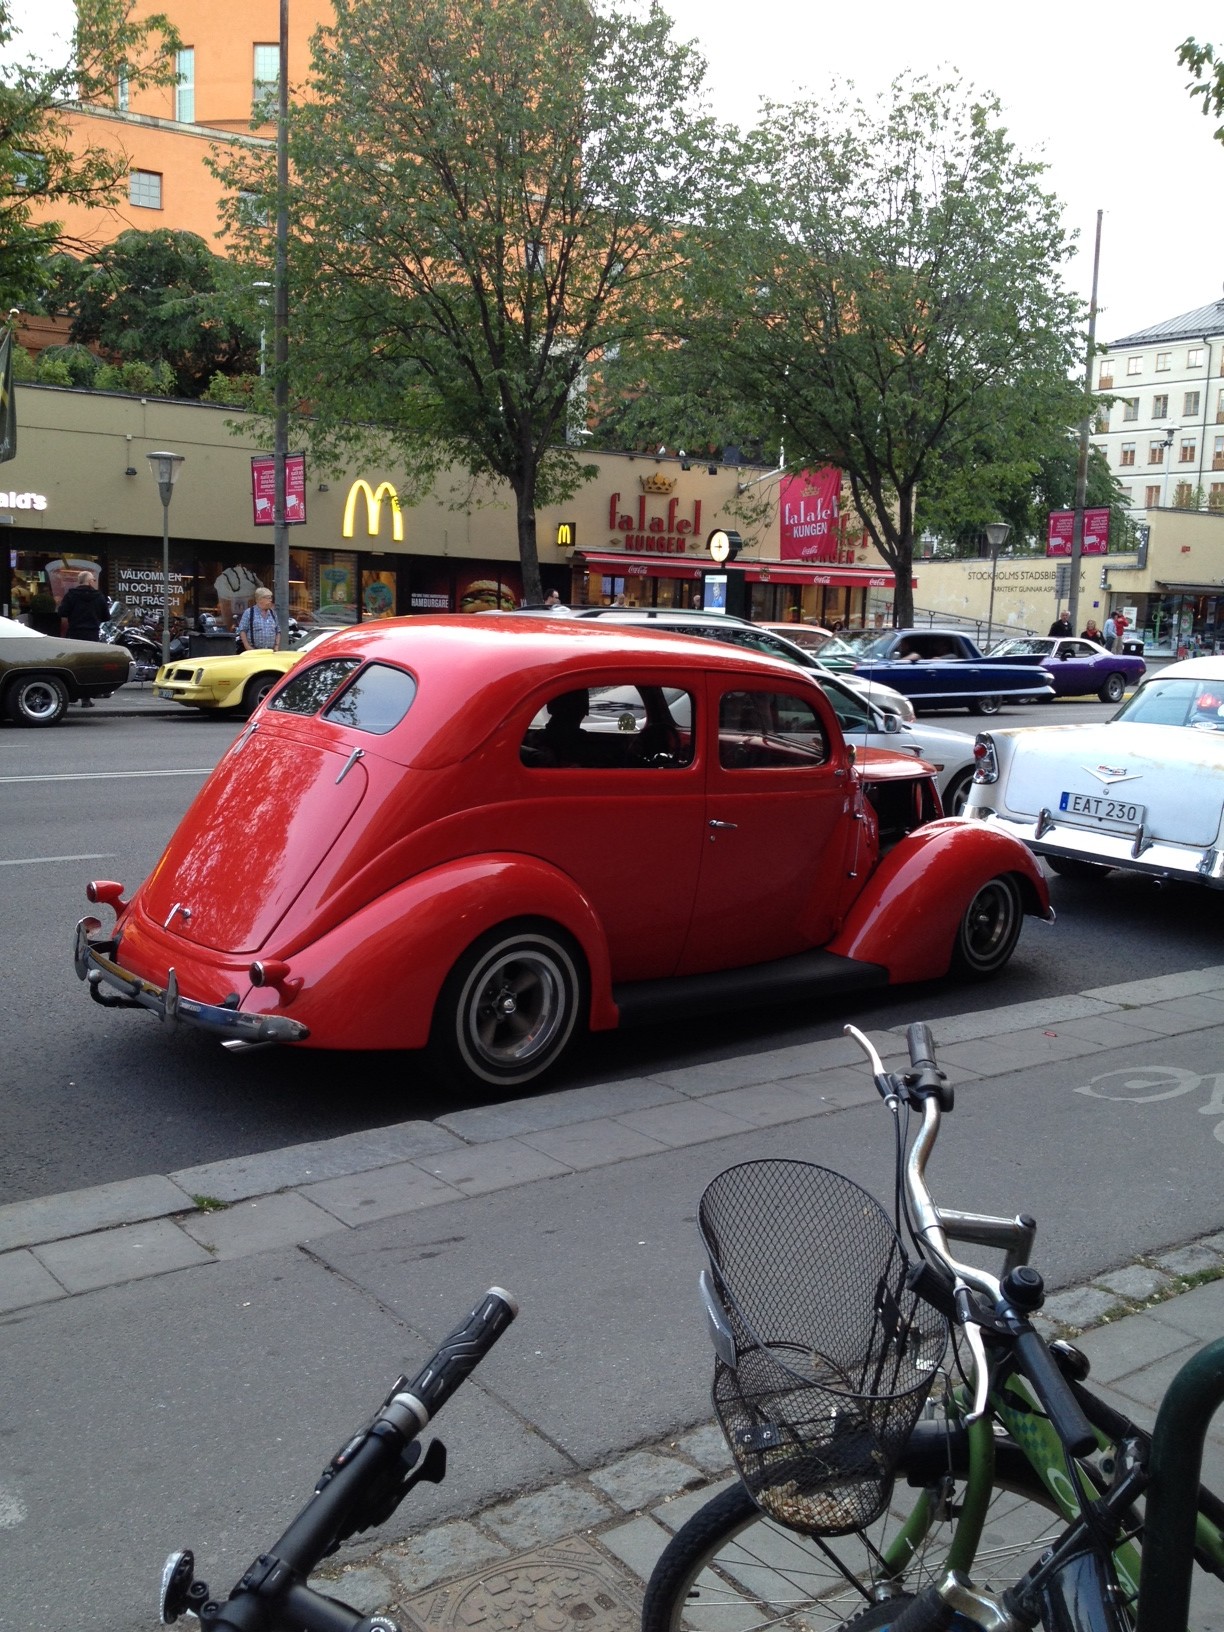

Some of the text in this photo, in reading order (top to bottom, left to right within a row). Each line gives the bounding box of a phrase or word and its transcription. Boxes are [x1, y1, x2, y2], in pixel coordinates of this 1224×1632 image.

[609, 492, 702, 537] falafel
[785, 495, 839, 526] falafel
[793, 521, 828, 538] KUNGEN
[625, 534, 686, 553] KUNGEN
[120, 568, 182, 582] VÄLKOMMEN
[967, 571, 1020, 580] STOCKHOLMS
[118, 583, 185, 594] IN OCH TESTA
[125, 594, 180, 606] EN FRÄSCH
[1072, 796, 1137, 821] EAT 230
